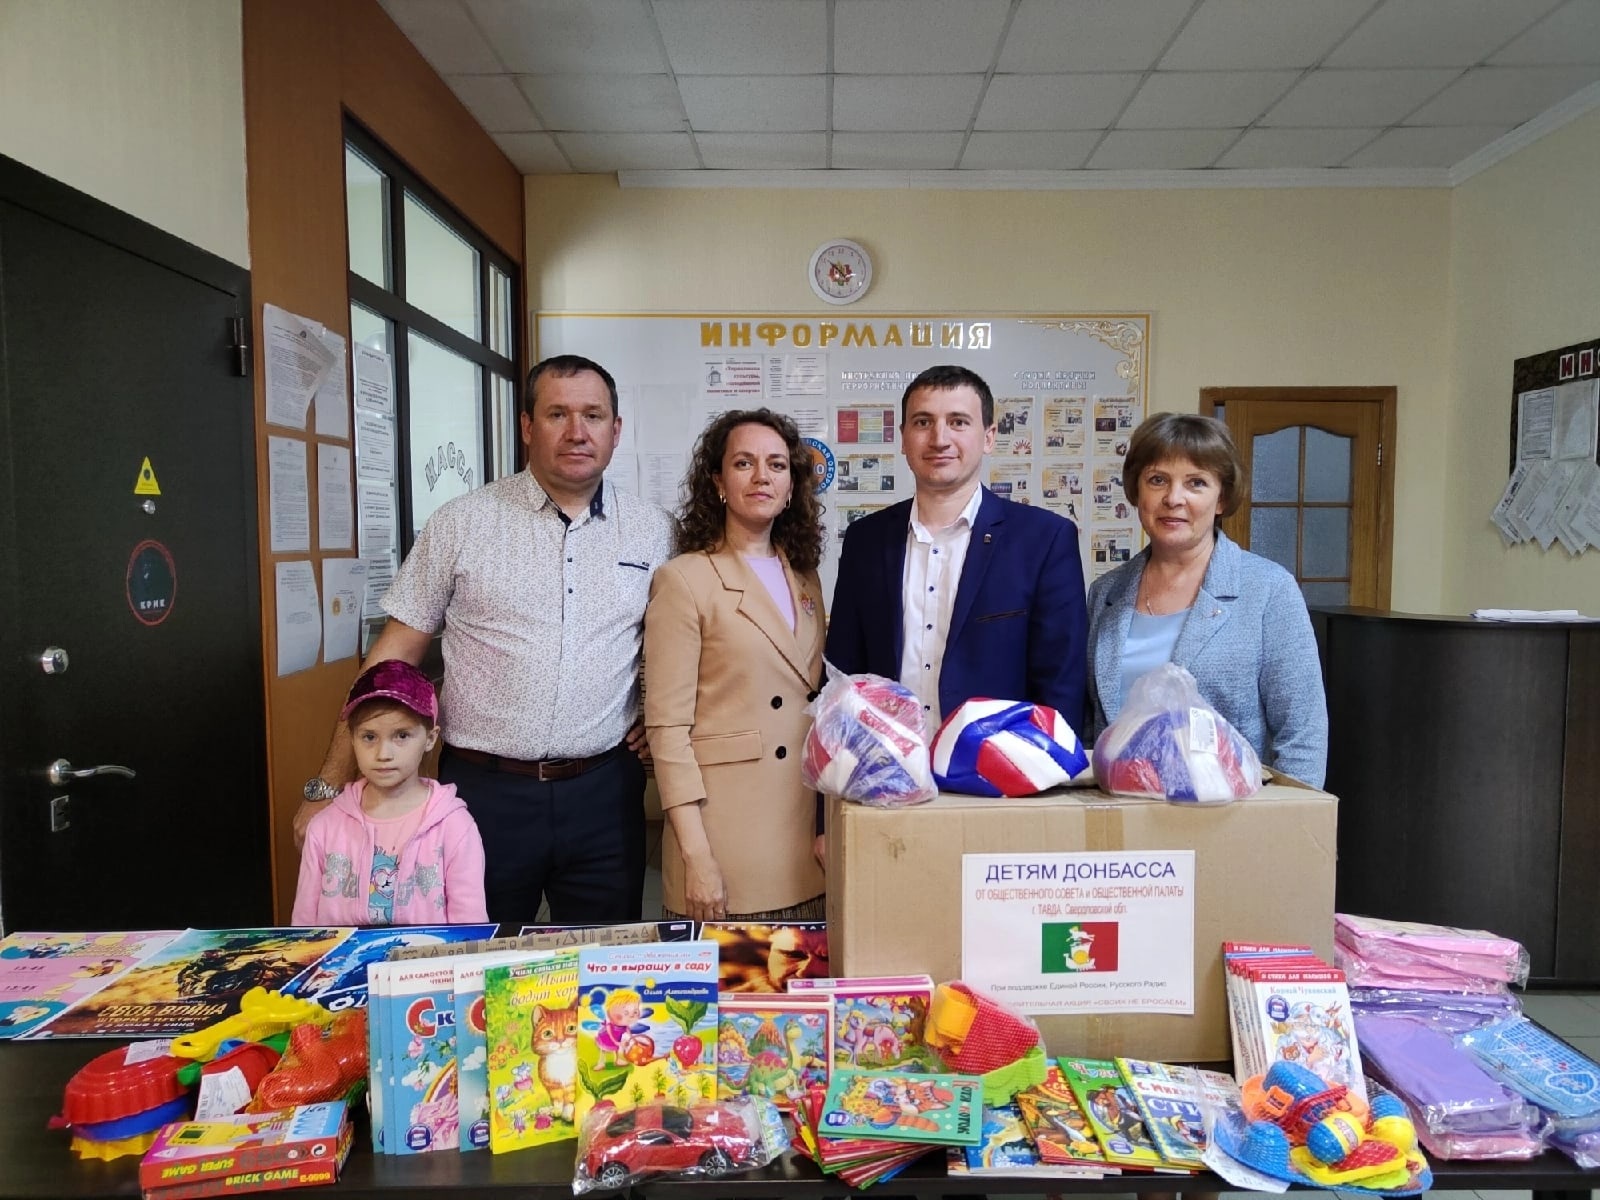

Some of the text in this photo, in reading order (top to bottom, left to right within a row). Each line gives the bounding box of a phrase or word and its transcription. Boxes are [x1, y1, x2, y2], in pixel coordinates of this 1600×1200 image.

[700, 322, 991, 349] ИНФОРМАЦИЯ
[1558, 349, 1600, 380] ИН
[424, 441, 474, 492] КАССА
[985, 861, 1176, 884] ДЕТЯМ ДОНБАССА
[975, 888, 985, 900] ОТ
[987, 887, 1053, 901] ОБЩЕСТВЕННОГО
[1055, 887, 1084, 899] СОВЕТА
[1092, 885, 1153, 900] ОБЩЕСТВЕННОЙ
[1154, 885, 1184, 897] ПАЛАТЫ
[509, 967, 532, 978] Учим
[534, 963, 561, 973] стихи
[586, 963, 607, 973] Что
[621, 963, 671, 974] выращу
[685, 961, 712, 972] саду
[400, 974, 413, 982] ДЛЯ
[991, 984, 1005, 993] При
[1049, 982, 1078, 991] Единой
[1270, 986, 1337, 995] Корней Чуковский
[510, 990, 551, 1006] водят
[154, 1003, 228, 1016] ВОЙНА
[162, 1158, 235, 1178] SUPER GAME
[225, 1172, 260, 1186] BRICK
[263, 1169, 299, 1181] GAME
